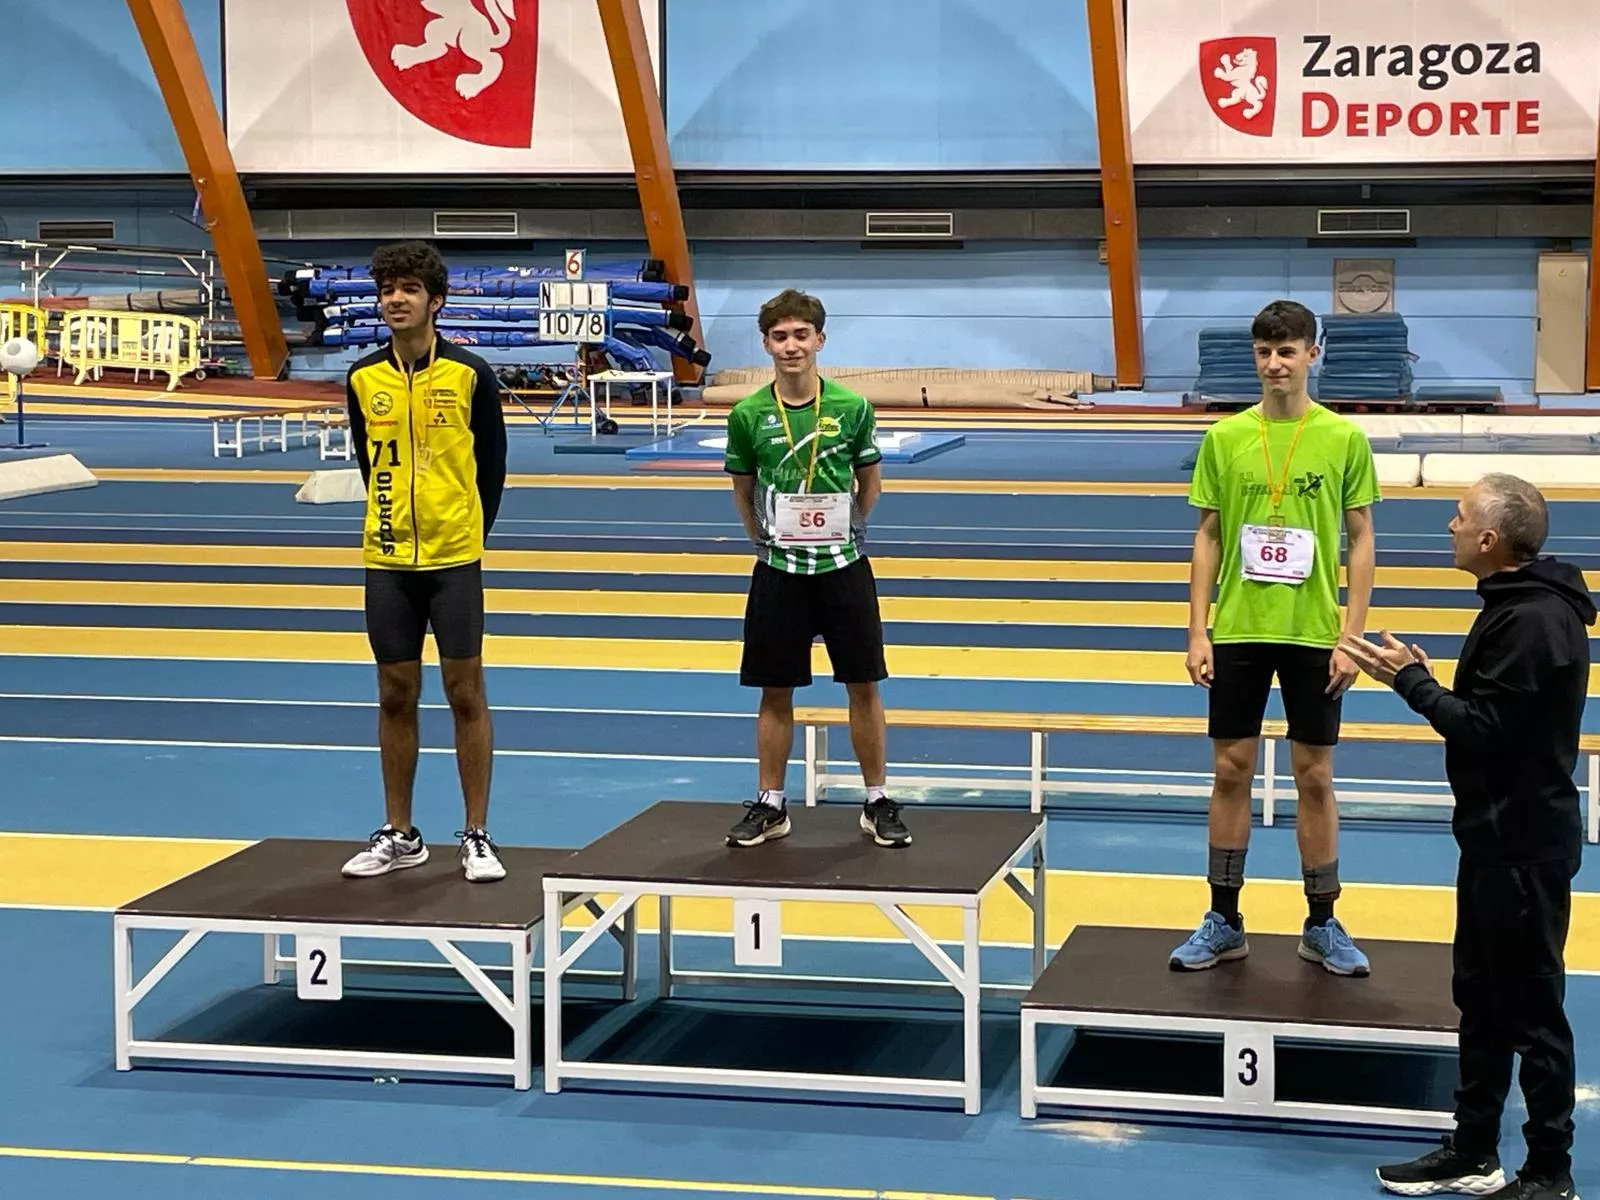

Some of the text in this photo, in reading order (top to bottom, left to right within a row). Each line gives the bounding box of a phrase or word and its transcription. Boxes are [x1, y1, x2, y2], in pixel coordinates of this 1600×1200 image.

[1302, 34, 1541, 91] Zaragoza
[1302, 91, 1541, 137] DEPORTE
[567, 251, 581, 275] 6
[542, 313, 603, 336] 1078
[372, 439, 402, 468] 71
[1260, 545, 1288, 563] 68
[750, 912, 761, 950] 1
[309, 948, 329, 986] 2
[1237, 1047, 1259, 1087] 3
